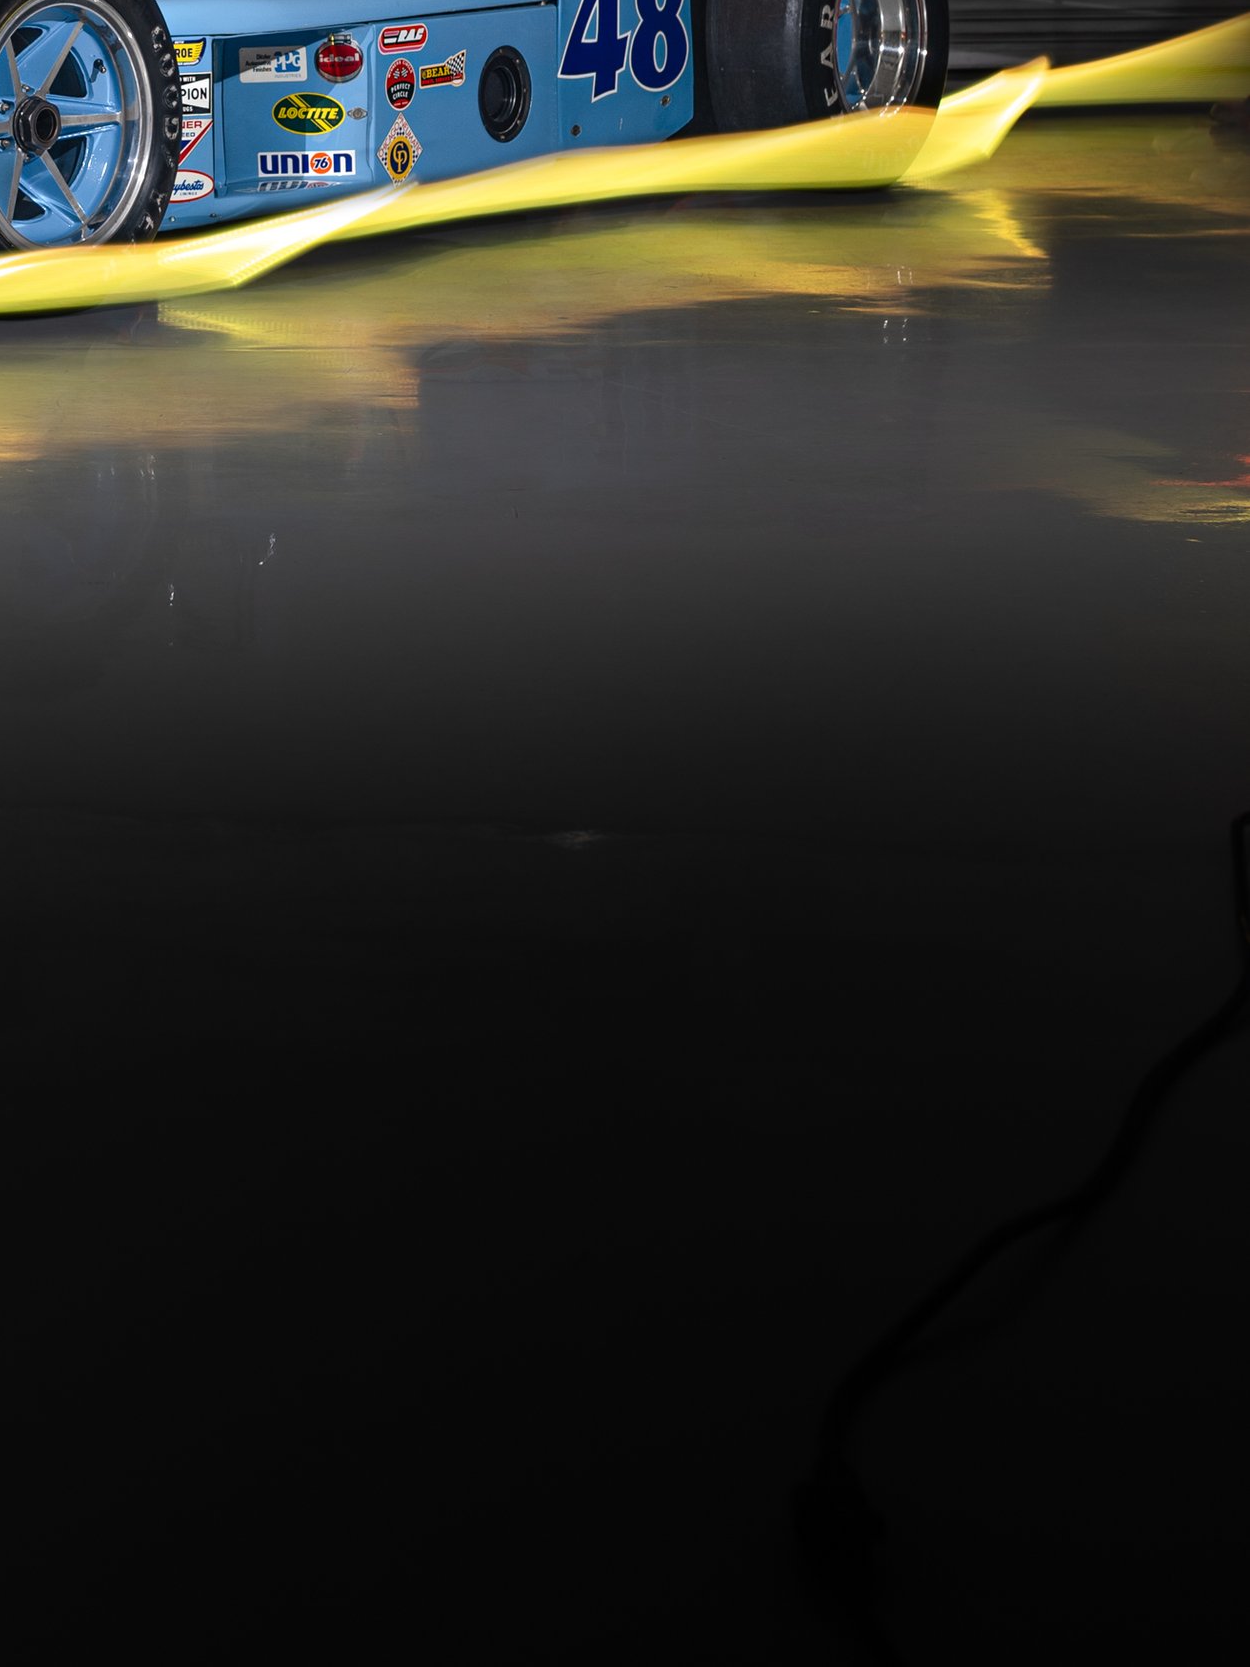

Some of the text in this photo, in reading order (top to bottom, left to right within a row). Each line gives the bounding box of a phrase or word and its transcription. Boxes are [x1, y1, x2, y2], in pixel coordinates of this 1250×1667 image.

[319, 53, 360, 63] ideal
[426, 66, 452, 79] BEAR
[390, 83, 411, 94] PERFECT
[392, 91, 408, 101] CIRCLE
[278, 107, 339, 119] LOCTITE
